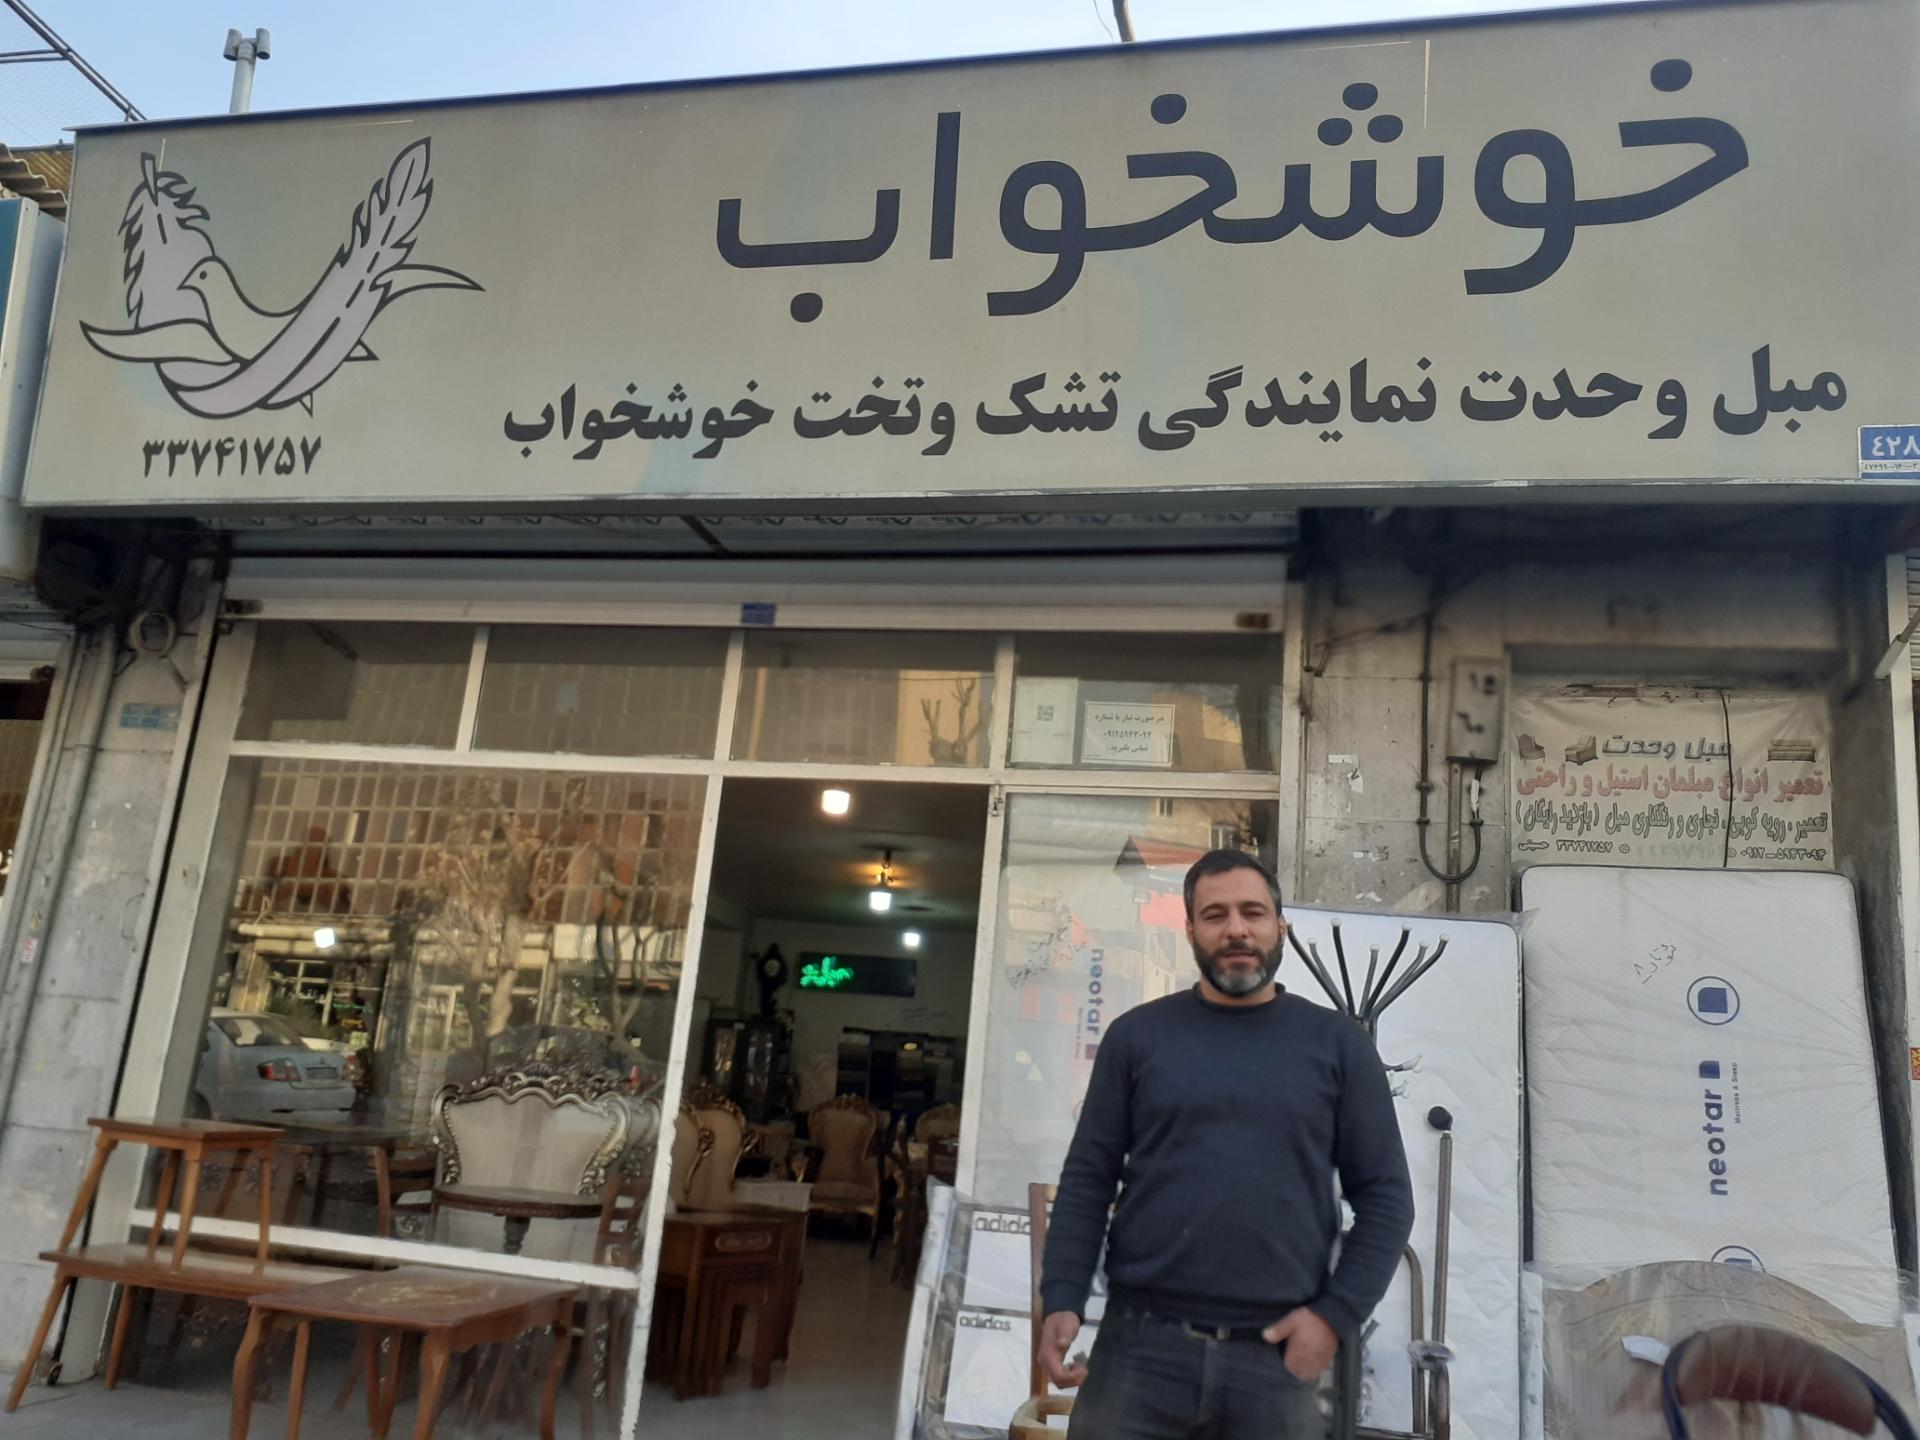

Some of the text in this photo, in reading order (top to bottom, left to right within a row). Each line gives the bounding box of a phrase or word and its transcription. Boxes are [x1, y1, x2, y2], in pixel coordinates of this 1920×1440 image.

[717, 59, 1749, 323] خوشخواب
[503, 379, 775, 460] خوشخواب
[976, 370, 1122, 435] تشک
[1138, 356, 1437, 452] نمایندگی
[1713, 343, 1847, 436] مبل
[142, 435, 322, 477] ۳۳۷۴۱۷۵۷
[1516, 762, 1824, 803] تعمیر انواع مبلمان استیل و راحتی
[1602, 735, 1732, 762] مبل وحدت
[1605, 802, 1631, 835] مبل
[1087, 949, 1104, 1036] neotar
[1702, 1088, 1729, 1196] neotar
[959, 1314, 1011, 1331] adidas
